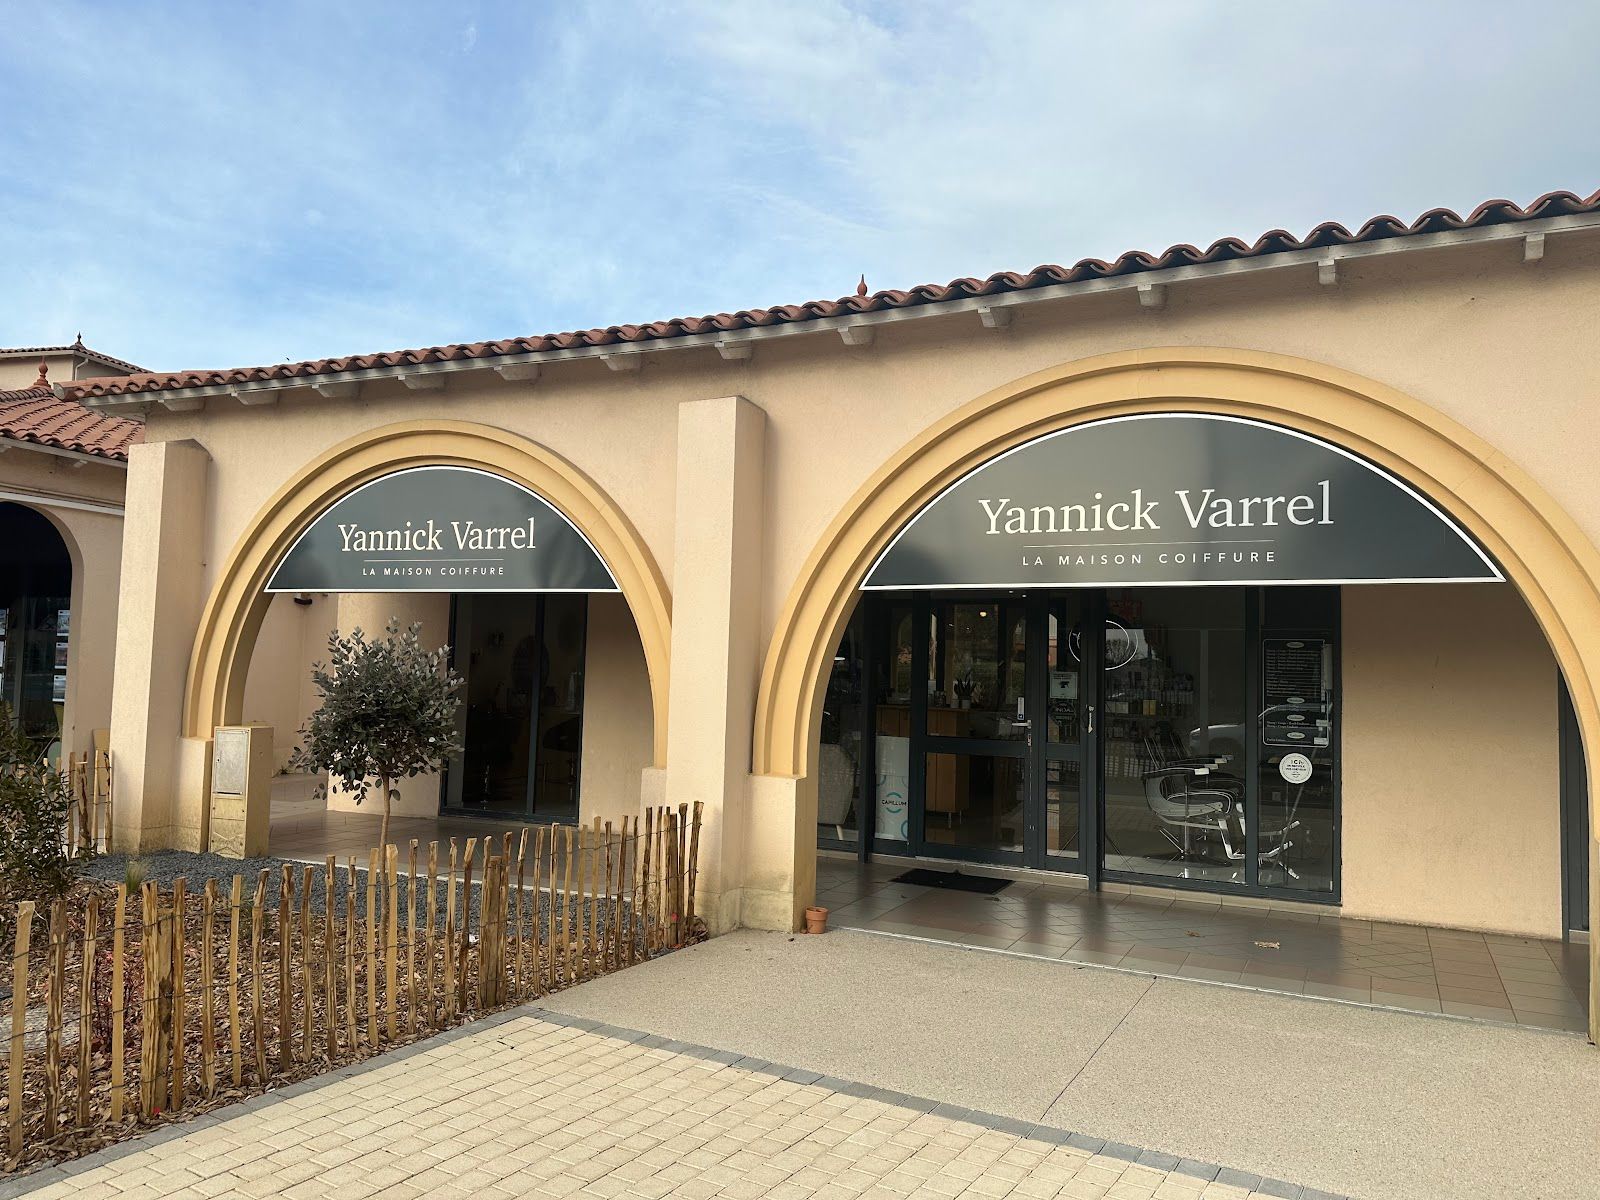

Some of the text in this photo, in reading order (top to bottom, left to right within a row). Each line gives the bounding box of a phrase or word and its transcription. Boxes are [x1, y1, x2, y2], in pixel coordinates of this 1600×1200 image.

[977, 479, 1335, 535] Yannick Varrel
[337, 516, 537, 552] Yannick Varrel
[362, 566, 505, 576] LA MAISON COIFFURE
[1022, 551, 1276, 567] LA MAISON COIFFURE
